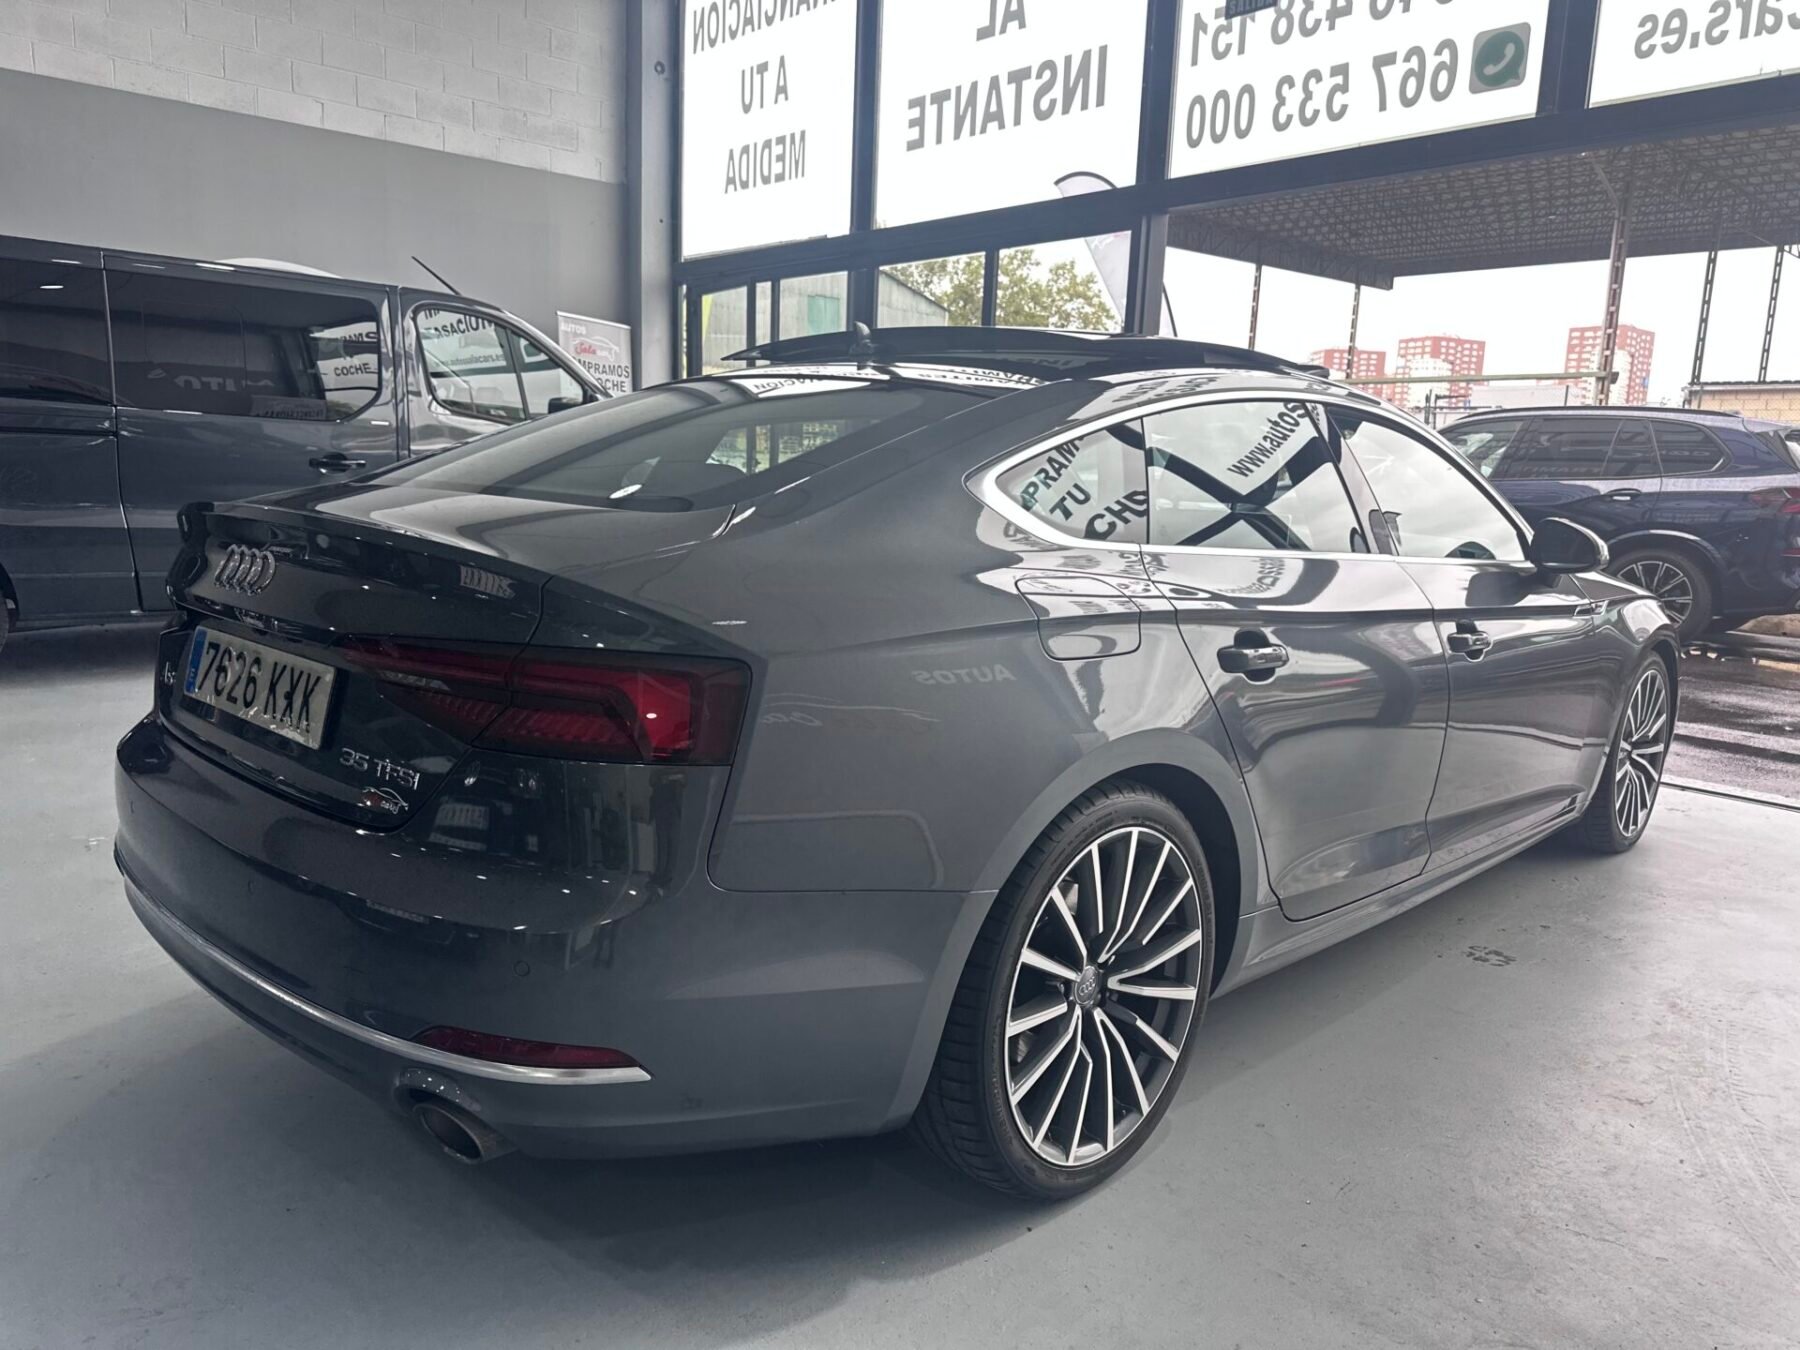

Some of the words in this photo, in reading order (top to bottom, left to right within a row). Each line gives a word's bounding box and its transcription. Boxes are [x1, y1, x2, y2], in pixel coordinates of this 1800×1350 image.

[333, 362, 372, 377] COCHE
[1048, 482, 1092, 521] TU
[197, 641, 262, 709] 7626
[263, 661, 323, 734] KXK
[340, 747, 370, 772] 35
[373, 758, 421, 790] TFSI
